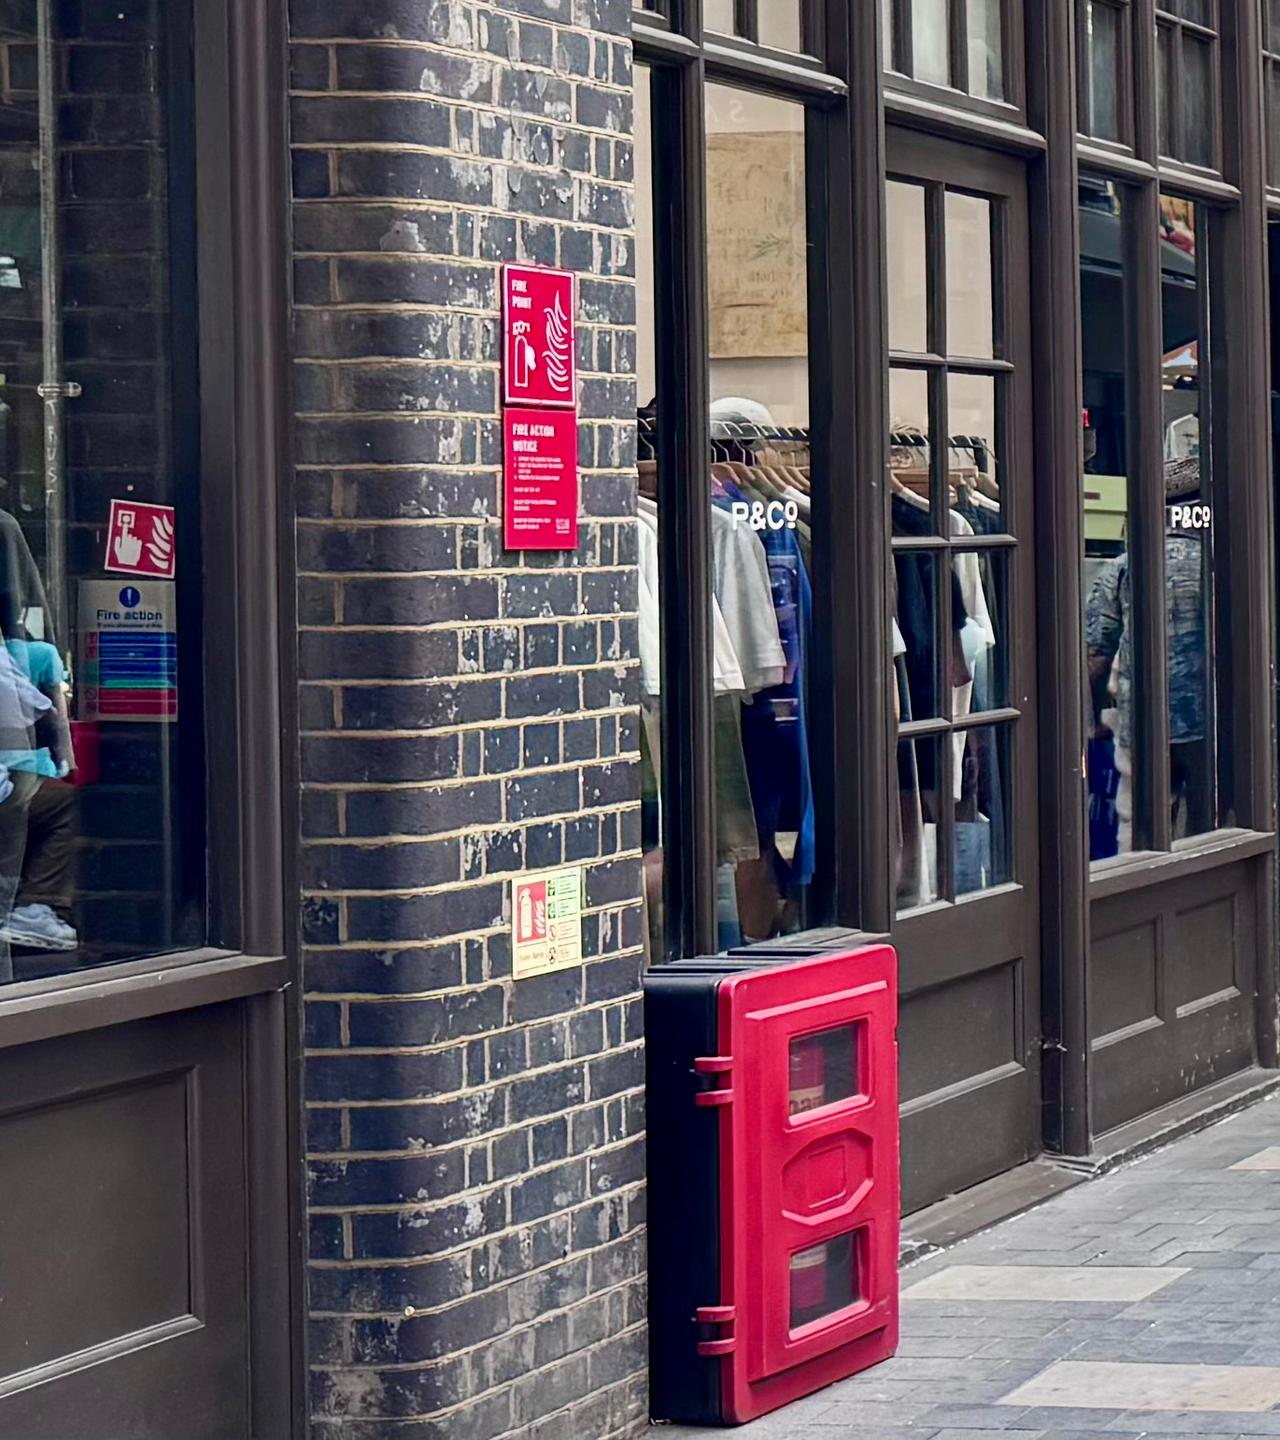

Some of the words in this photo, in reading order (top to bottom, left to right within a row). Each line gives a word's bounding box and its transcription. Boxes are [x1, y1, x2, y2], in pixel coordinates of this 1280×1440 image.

[511, 278, 528, 293] FIRE
[511, 296, 532, 310] POINT
[512, 423, 529, 436] FIRE
[530, 423, 555, 438] ACTION
[96, 609, 121, 621] Fire
[123, 609, 163, 621] action
